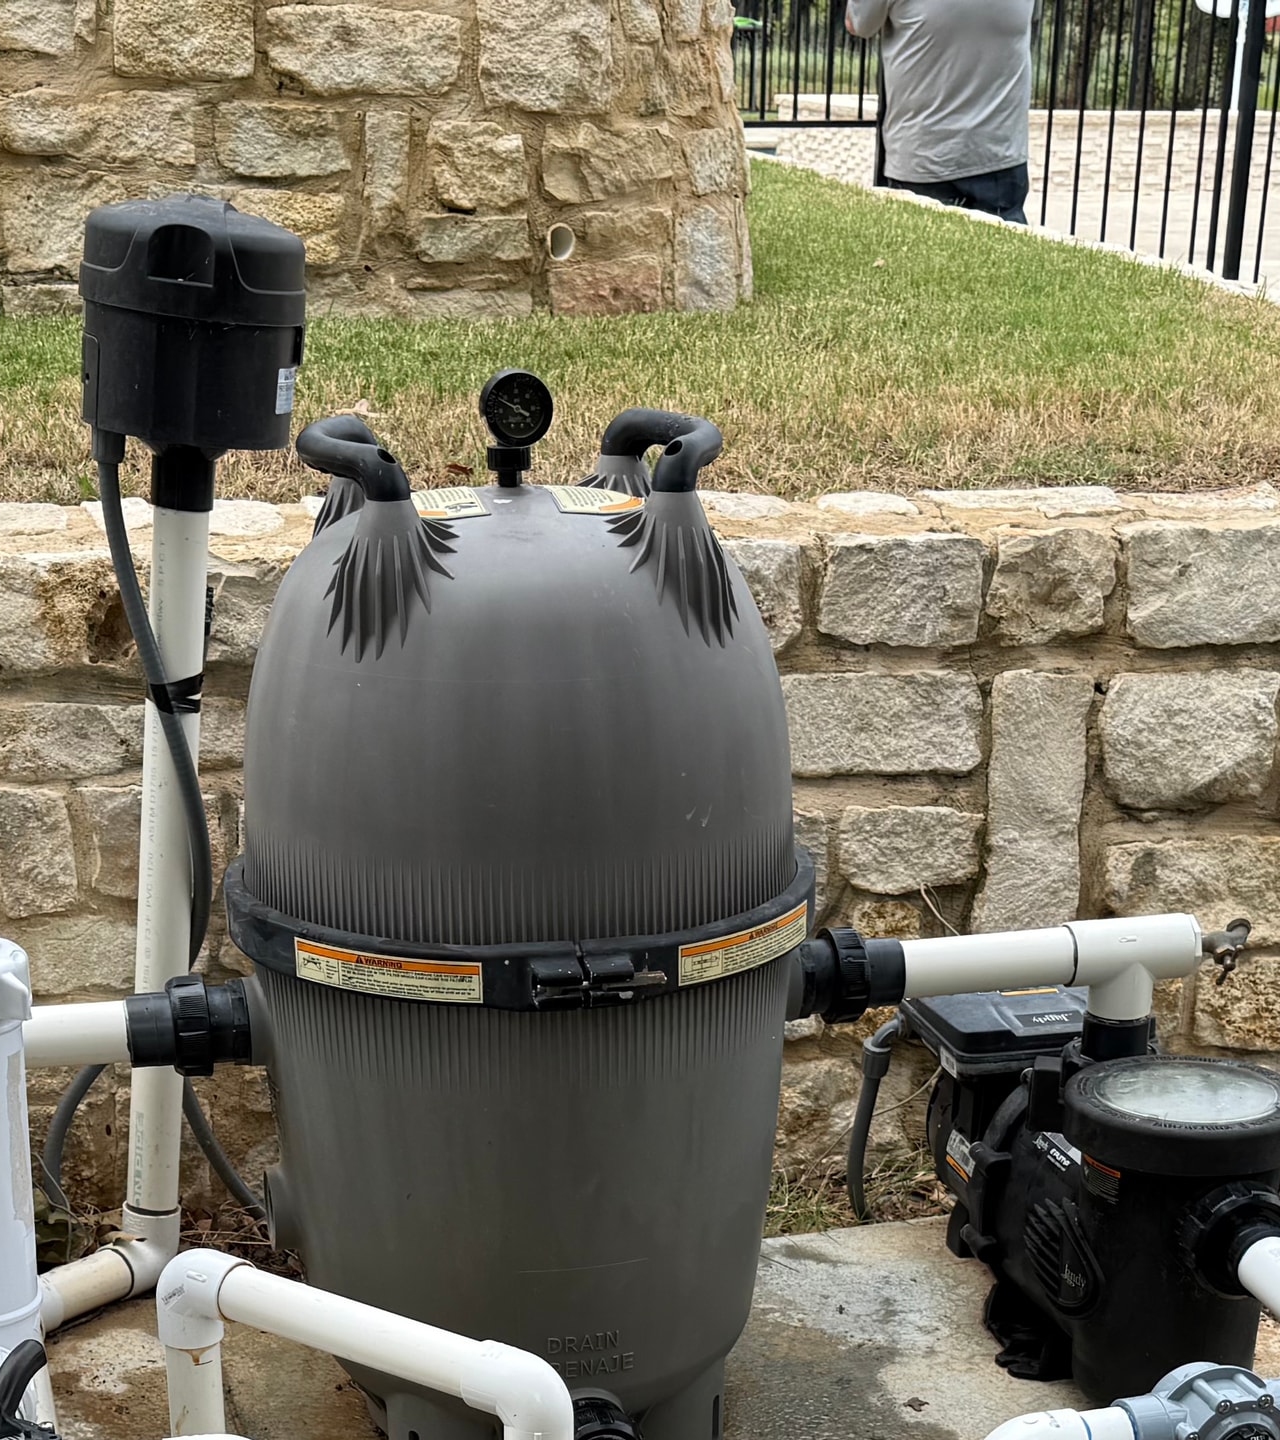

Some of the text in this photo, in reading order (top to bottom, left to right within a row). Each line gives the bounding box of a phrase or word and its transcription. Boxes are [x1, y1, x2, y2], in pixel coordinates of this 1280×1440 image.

[363, 957, 402, 969] WARNING
[547, 1330, 619, 1354] DRAIN
[551, 1352, 634, 1378] ENAJE
